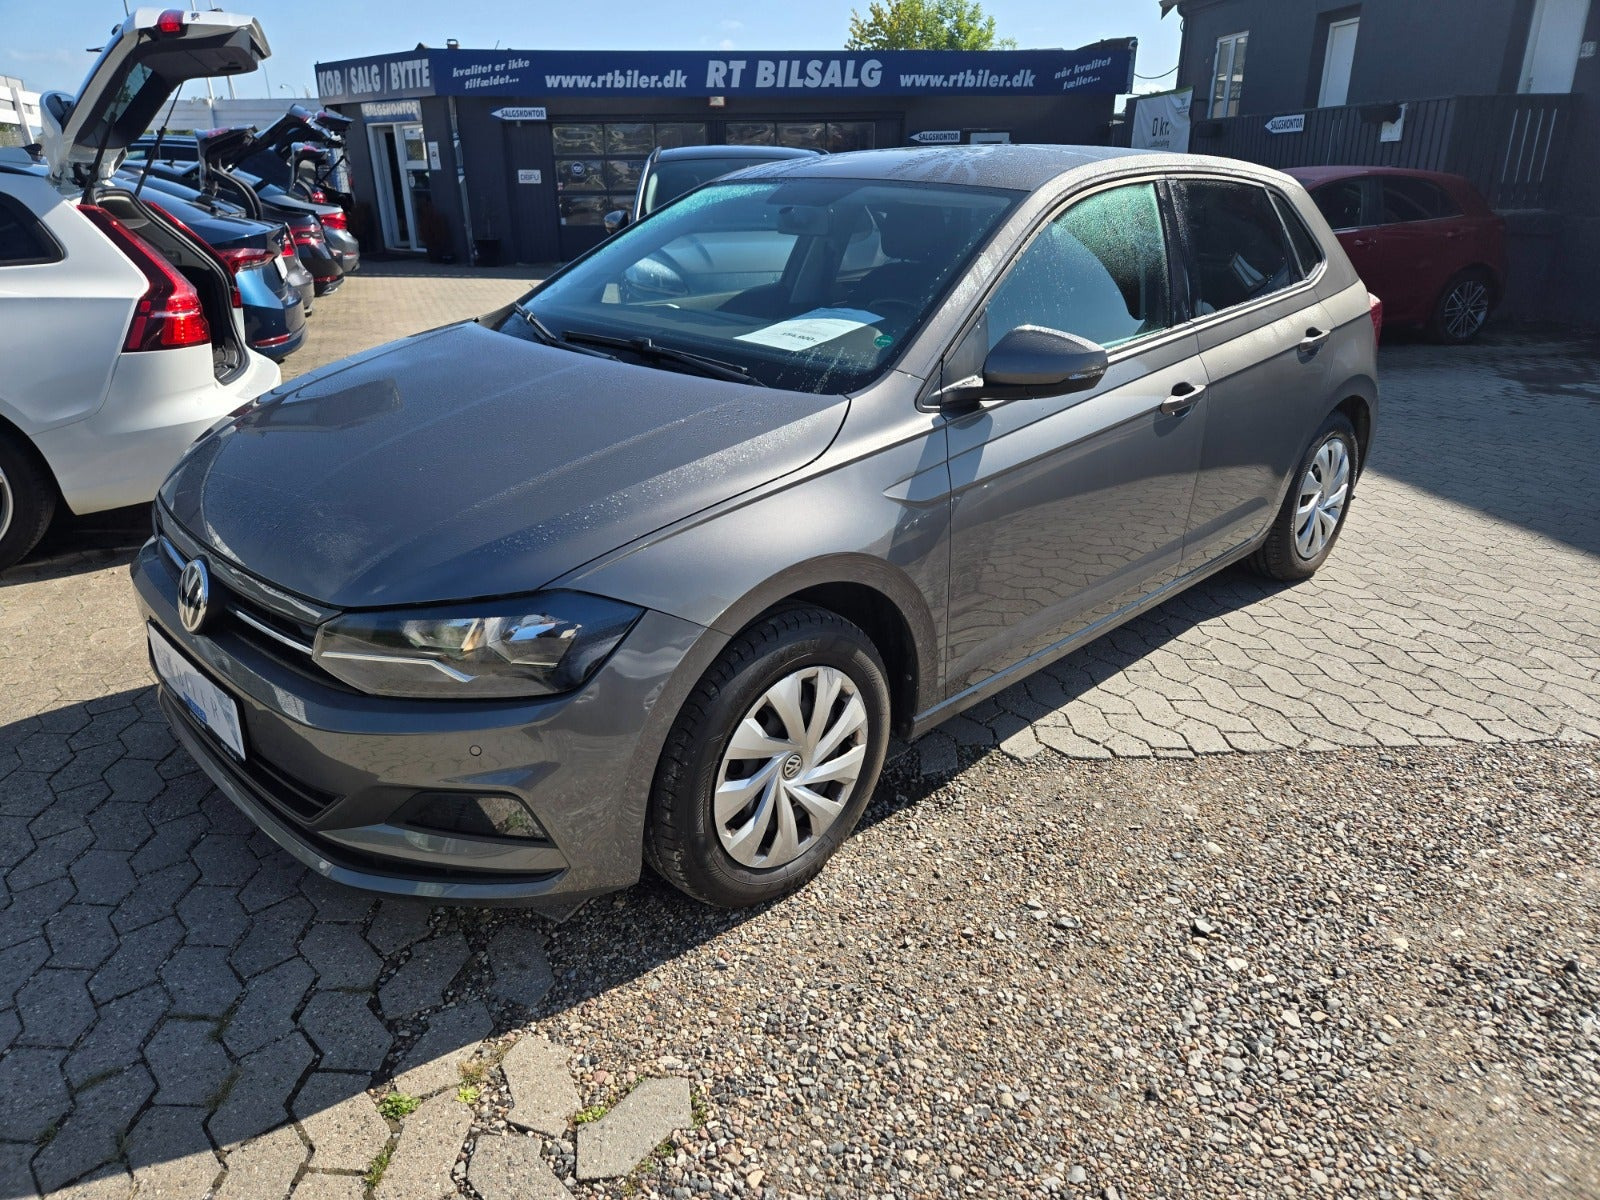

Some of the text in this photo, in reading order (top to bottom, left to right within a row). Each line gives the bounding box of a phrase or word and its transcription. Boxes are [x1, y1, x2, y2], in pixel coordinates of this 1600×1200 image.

[453, 58, 530, 77] kvalitet er ikke
[706, 59, 883, 88] RT BILSALG
[1055, 57, 1111, 79] når kvalitet
[318, 70, 343, 97] KØB
[350, 64, 380, 94] SALG
[390, 58, 430, 90] BYTTE
[545, 69, 687, 88] www.rtbiler.dk
[900, 69, 1036, 87] www.rtbiler.dk
[363, 101, 418, 116] SALGSKONTOR
[500, 109, 545, 118] SALGSKONTOR
[1270, 117, 1304, 130] SALGSKONTOR
[918, 132, 959, 141] SALGSKONTOR
